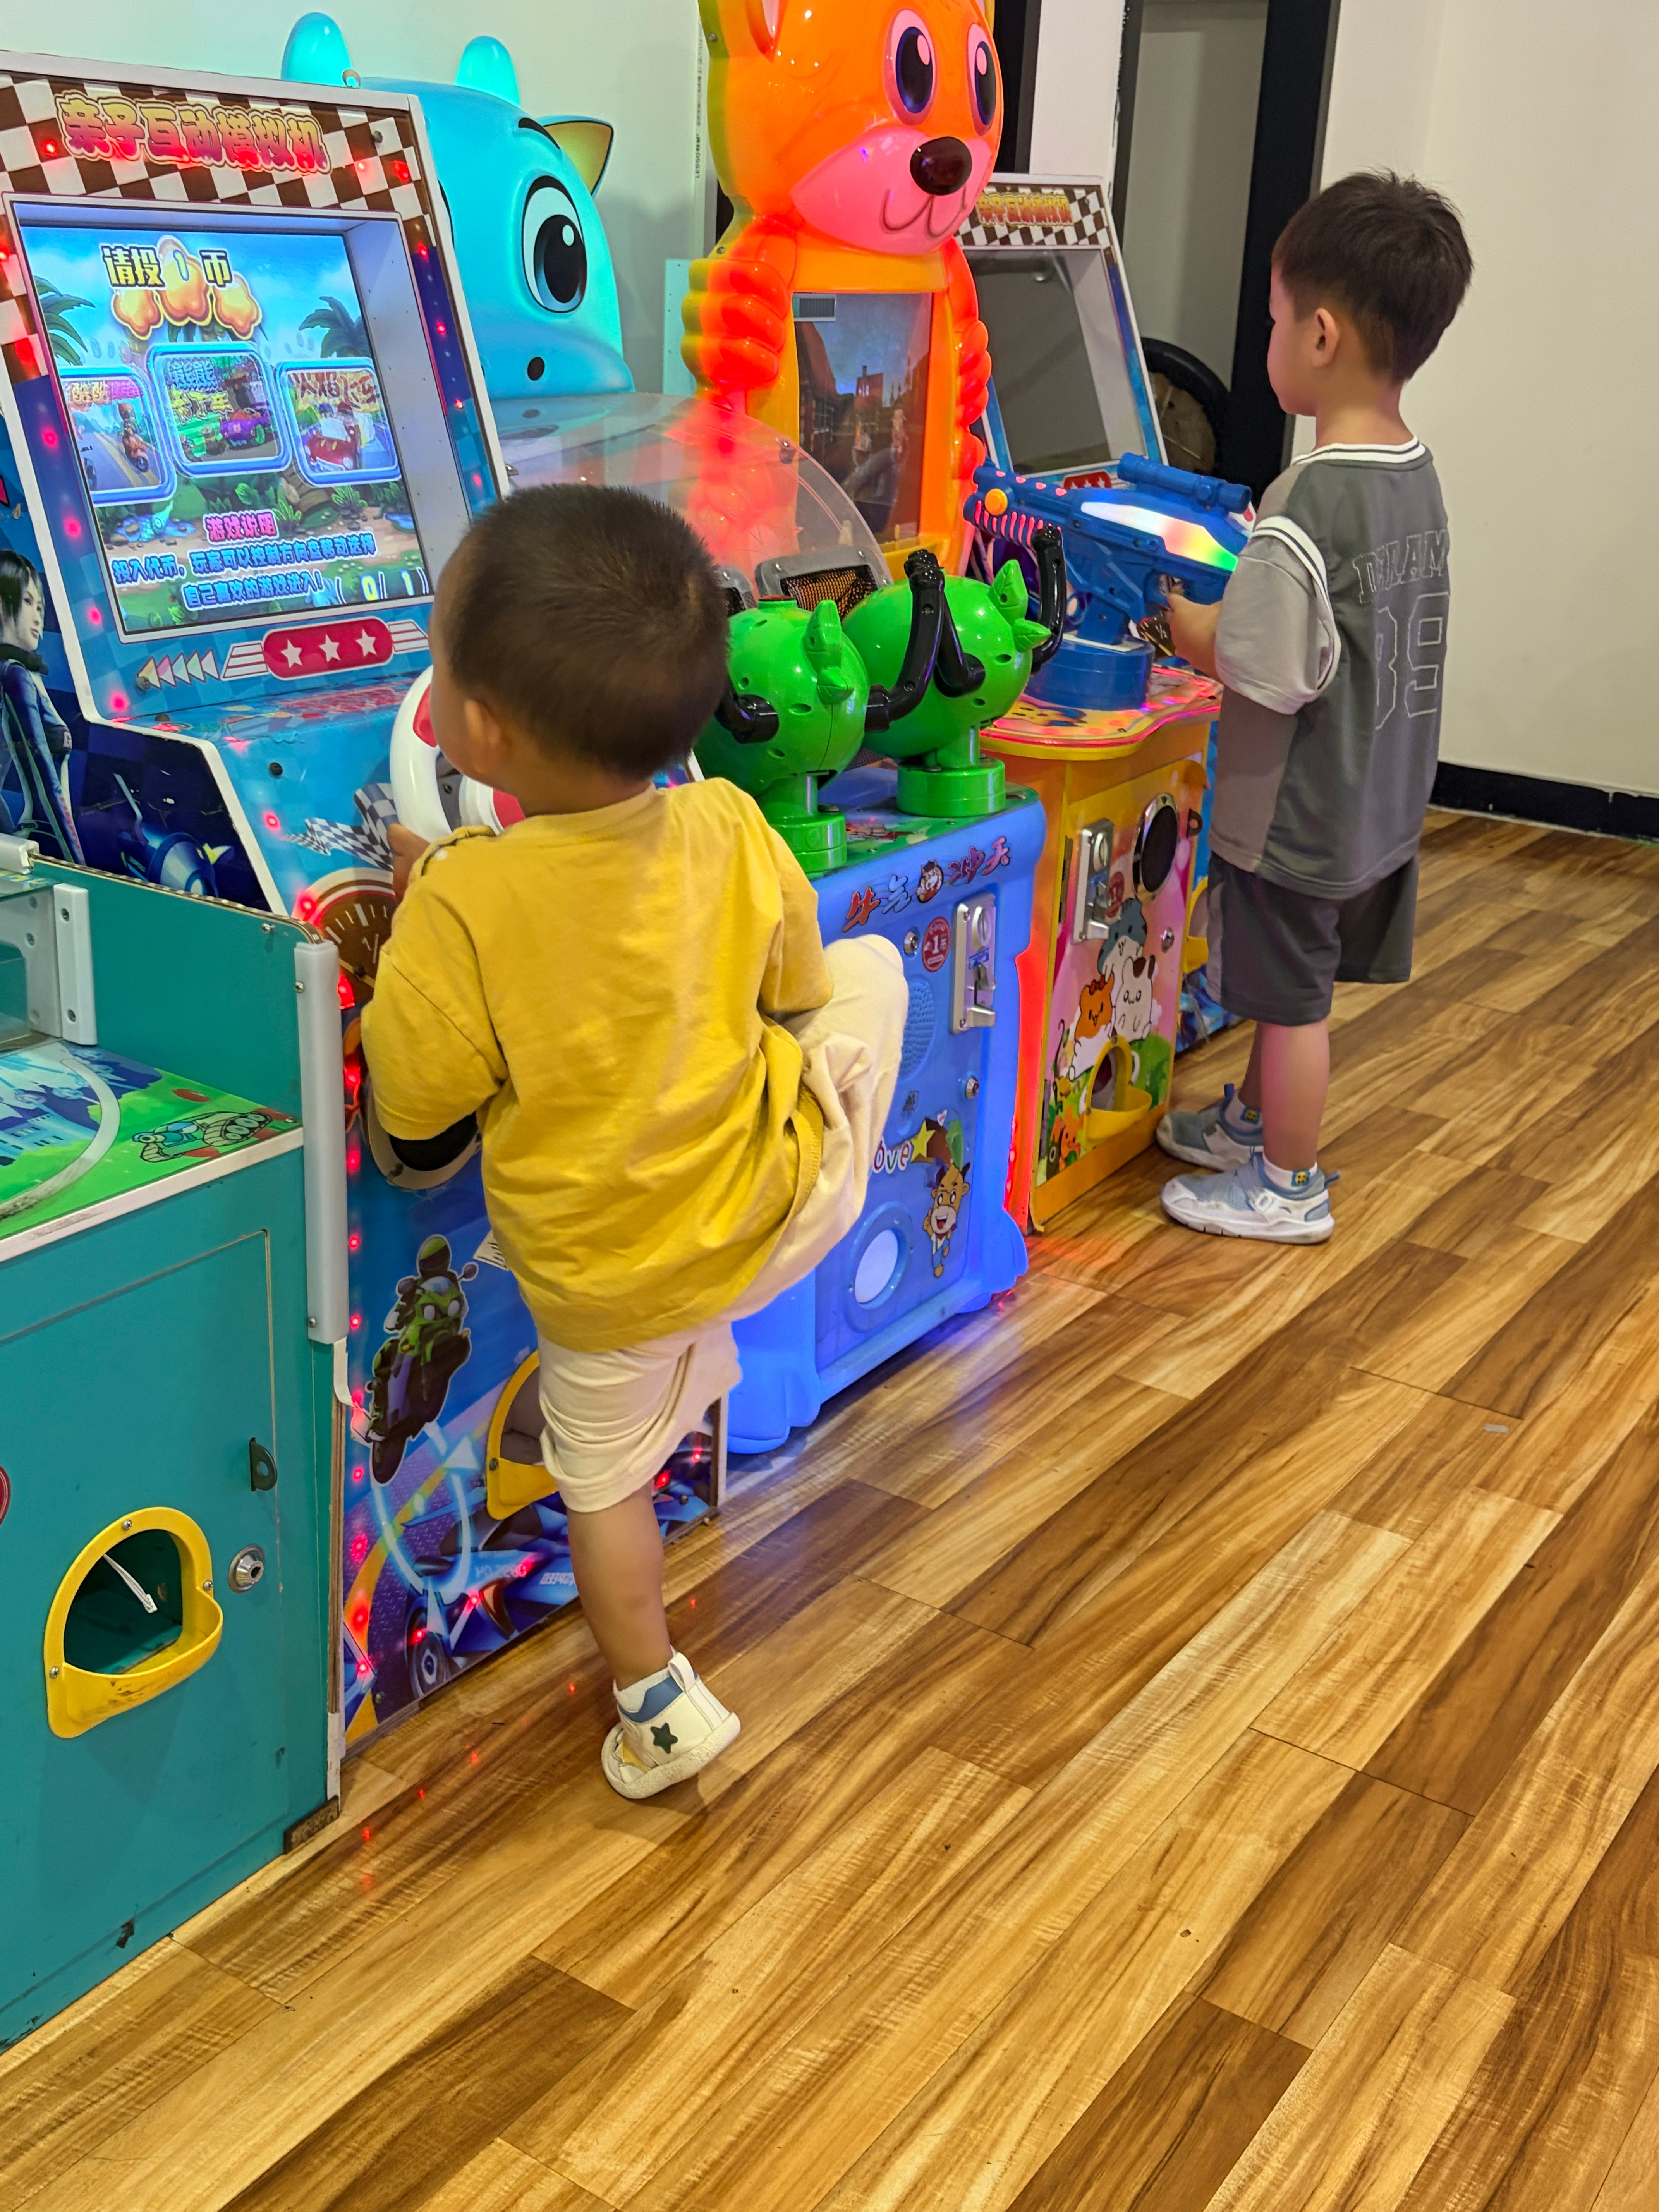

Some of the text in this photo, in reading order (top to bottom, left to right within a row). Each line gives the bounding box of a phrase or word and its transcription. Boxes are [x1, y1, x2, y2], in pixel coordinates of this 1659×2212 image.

[59, 98, 328, 170] 亲子互动模拟机
[205, 512, 277, 543] 游戏说明
[874, 1140, 910, 1171] ove
